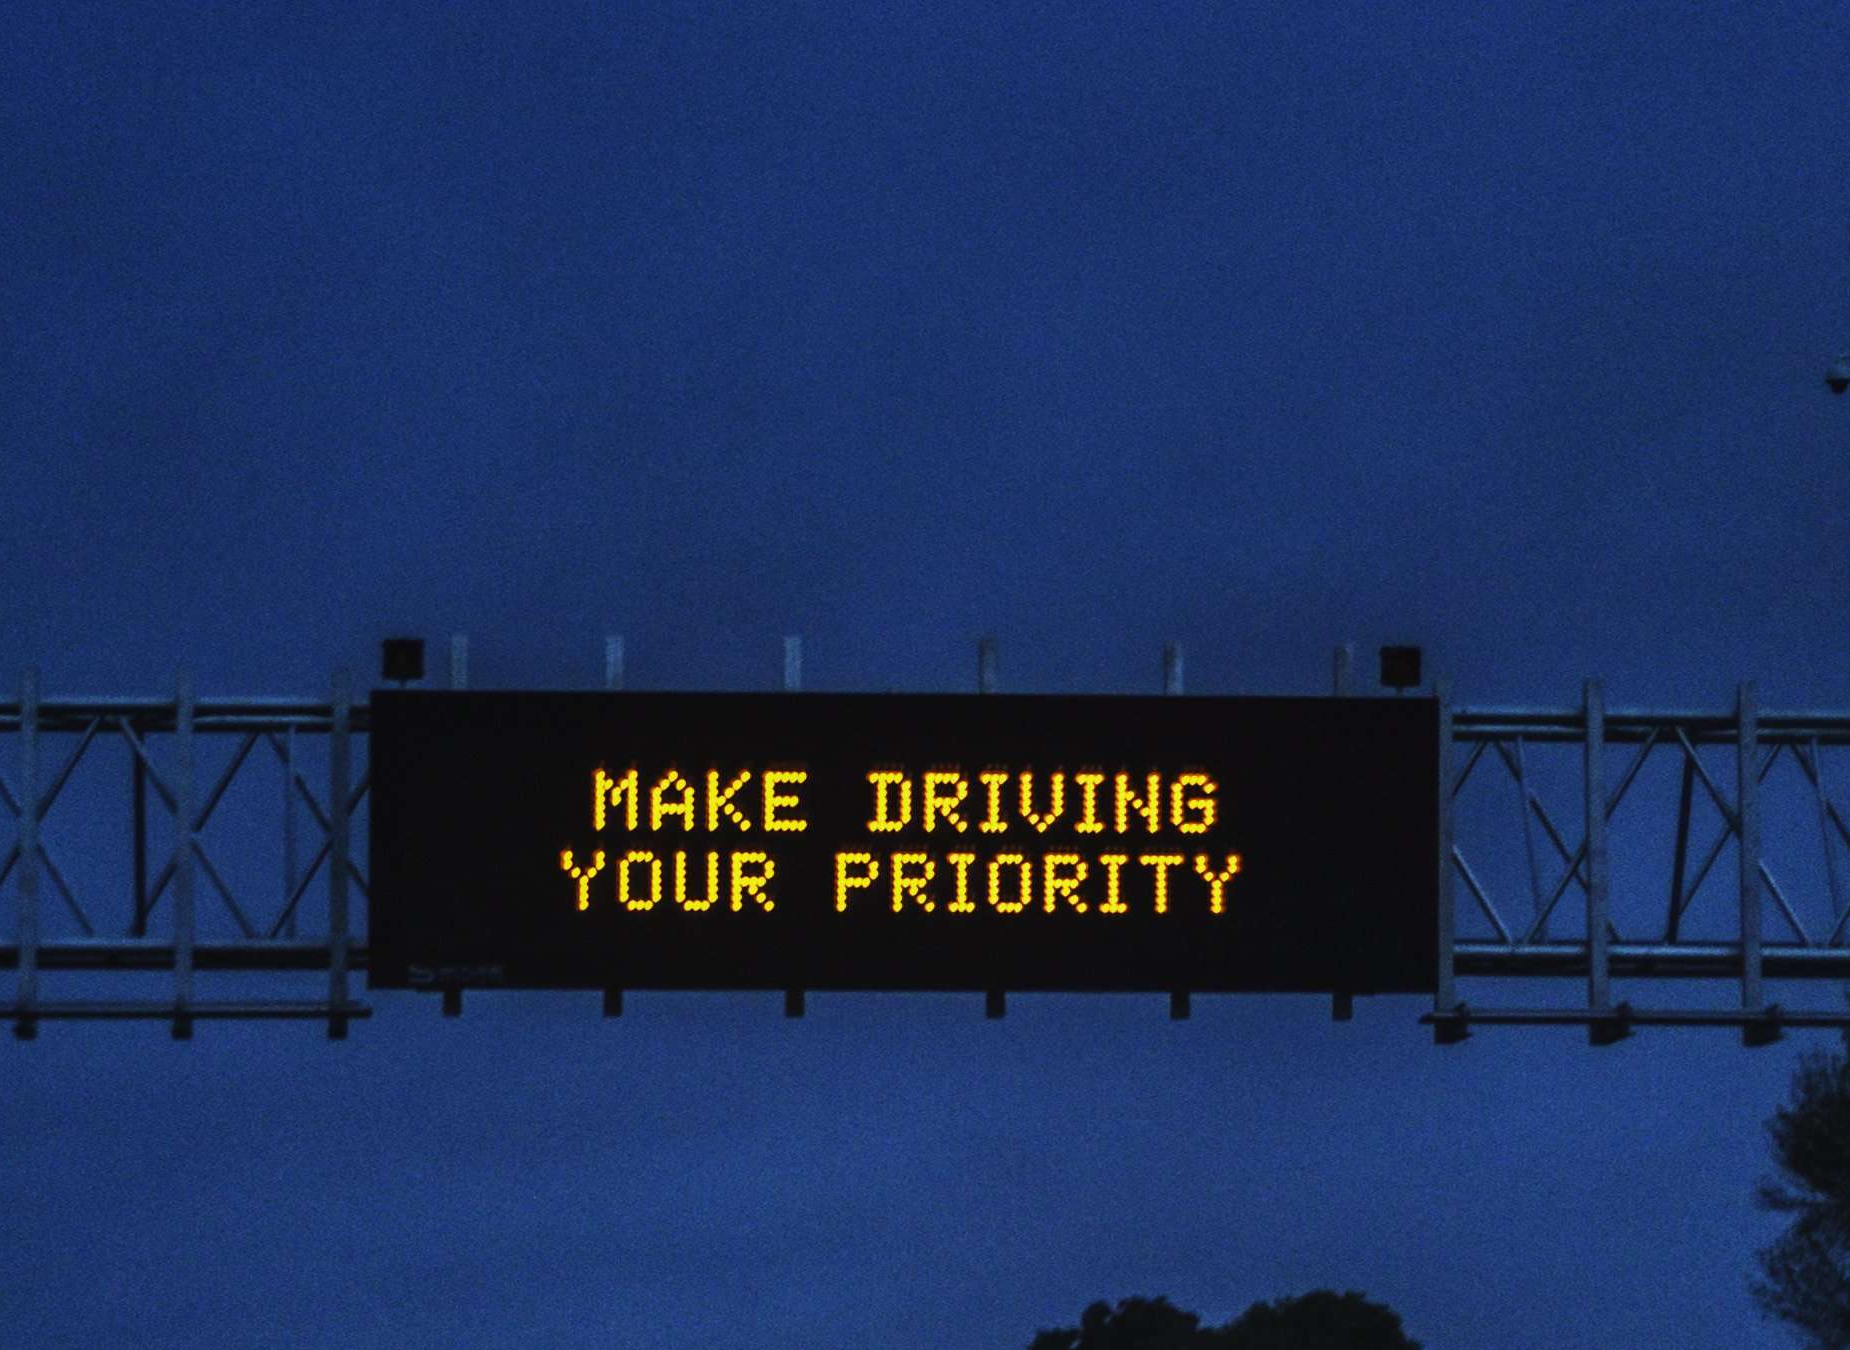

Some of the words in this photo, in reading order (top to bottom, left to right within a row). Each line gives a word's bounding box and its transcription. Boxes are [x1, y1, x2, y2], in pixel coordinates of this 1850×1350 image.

[592, 768, 809, 833] MAKE
[865, 770, 1219, 834] DRIVING
[559, 849, 777, 914] YOUR
[833, 851, 1242, 915] PRIORITY
